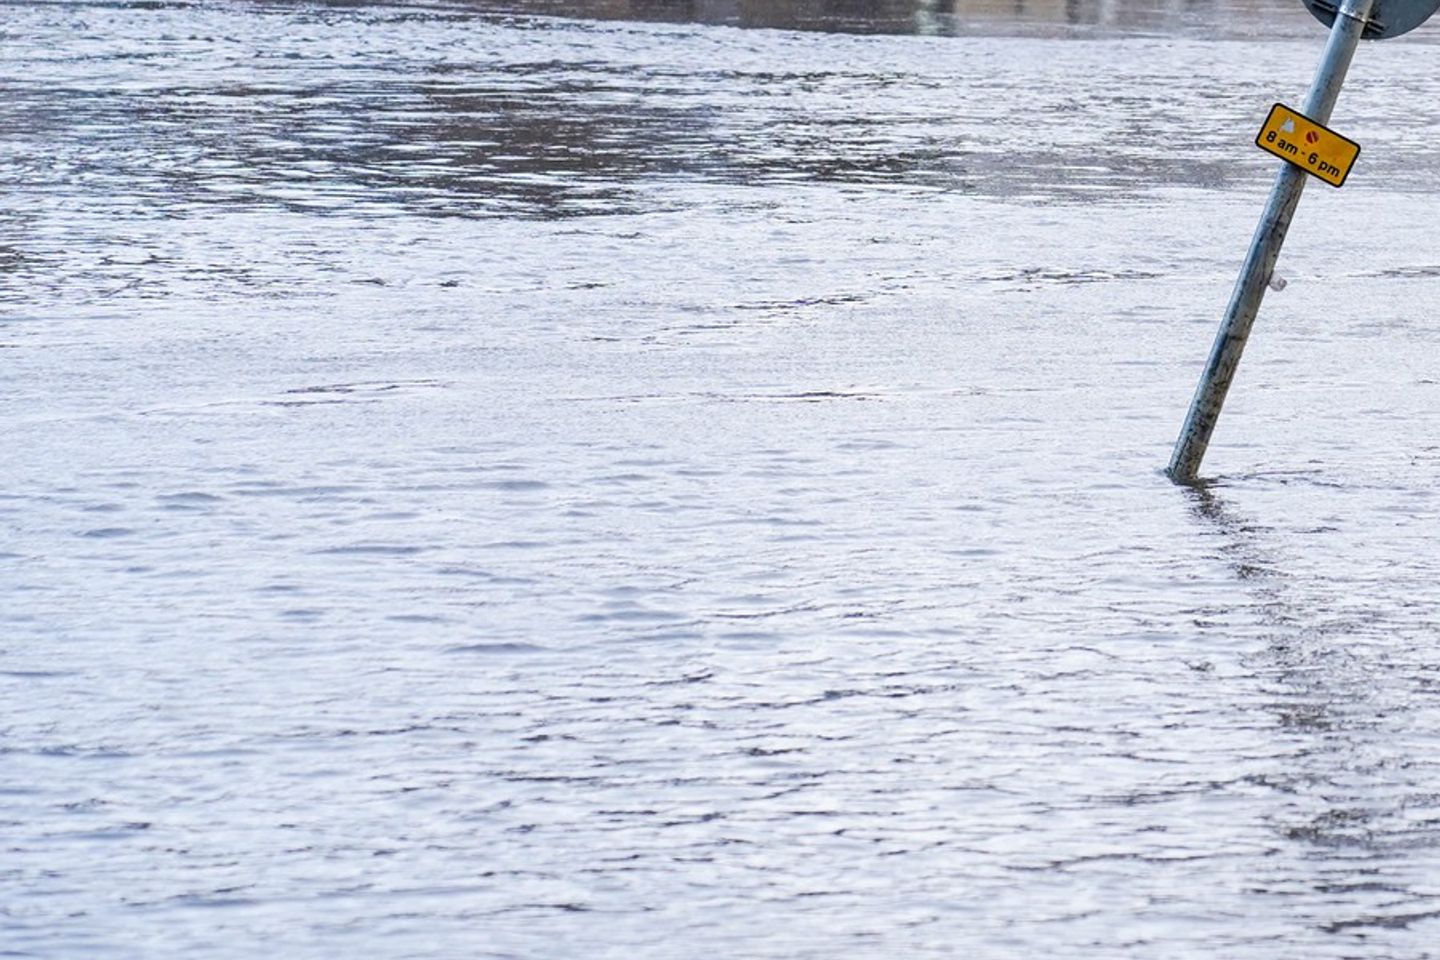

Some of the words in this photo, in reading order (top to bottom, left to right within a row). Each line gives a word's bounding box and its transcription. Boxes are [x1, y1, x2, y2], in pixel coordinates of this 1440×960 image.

[1266, 131, 1277, 142] 8
[1277, 140, 1299, 156] am
[1307, 152, 1318, 165] 6
[1318, 161, 1340, 177] pm
